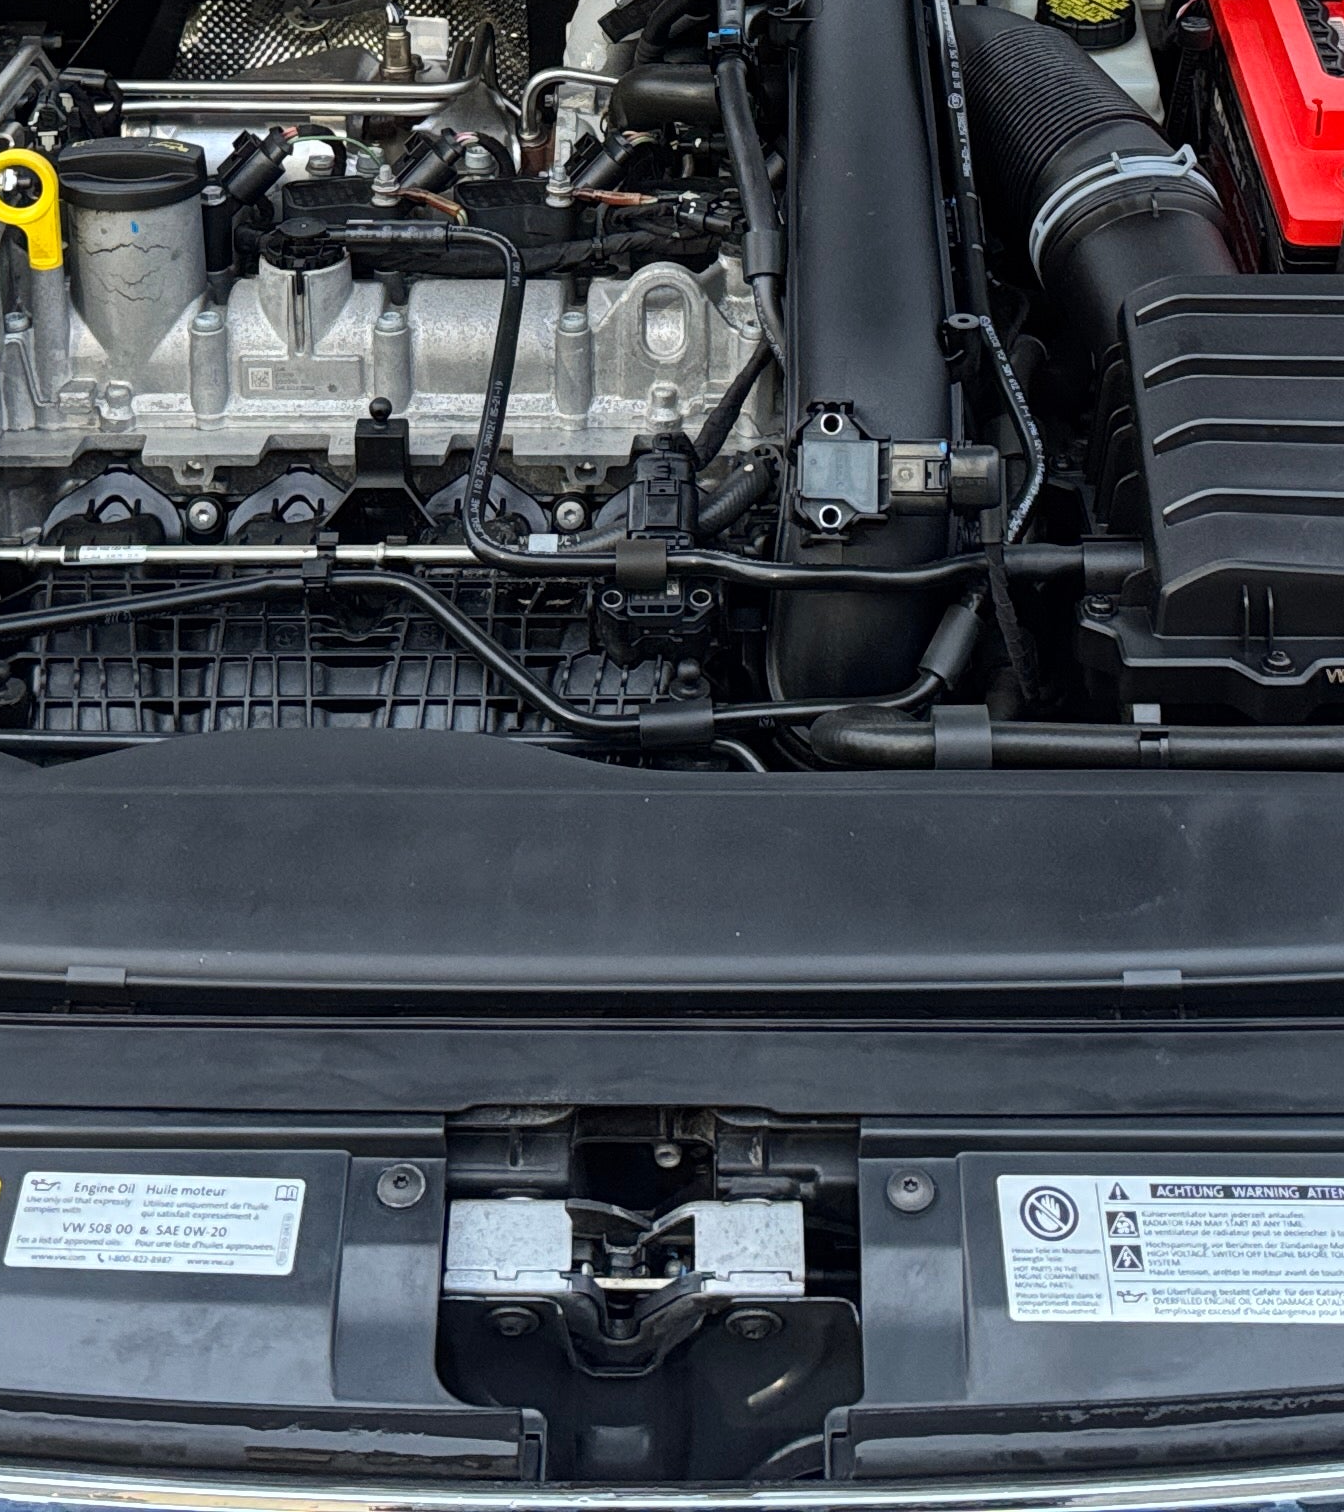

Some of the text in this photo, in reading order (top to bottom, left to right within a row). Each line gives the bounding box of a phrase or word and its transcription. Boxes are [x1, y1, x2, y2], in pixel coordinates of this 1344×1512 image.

[74, 1182, 226, 1197] Engine Oil Huile moteur
[1156, 1186, 1224, 1198] ACHTUNG
[1232, 1186, 1299, 1198] WARNING
[62, 1222, 227, 1237] VW 508 00 & SAE 0W-20
